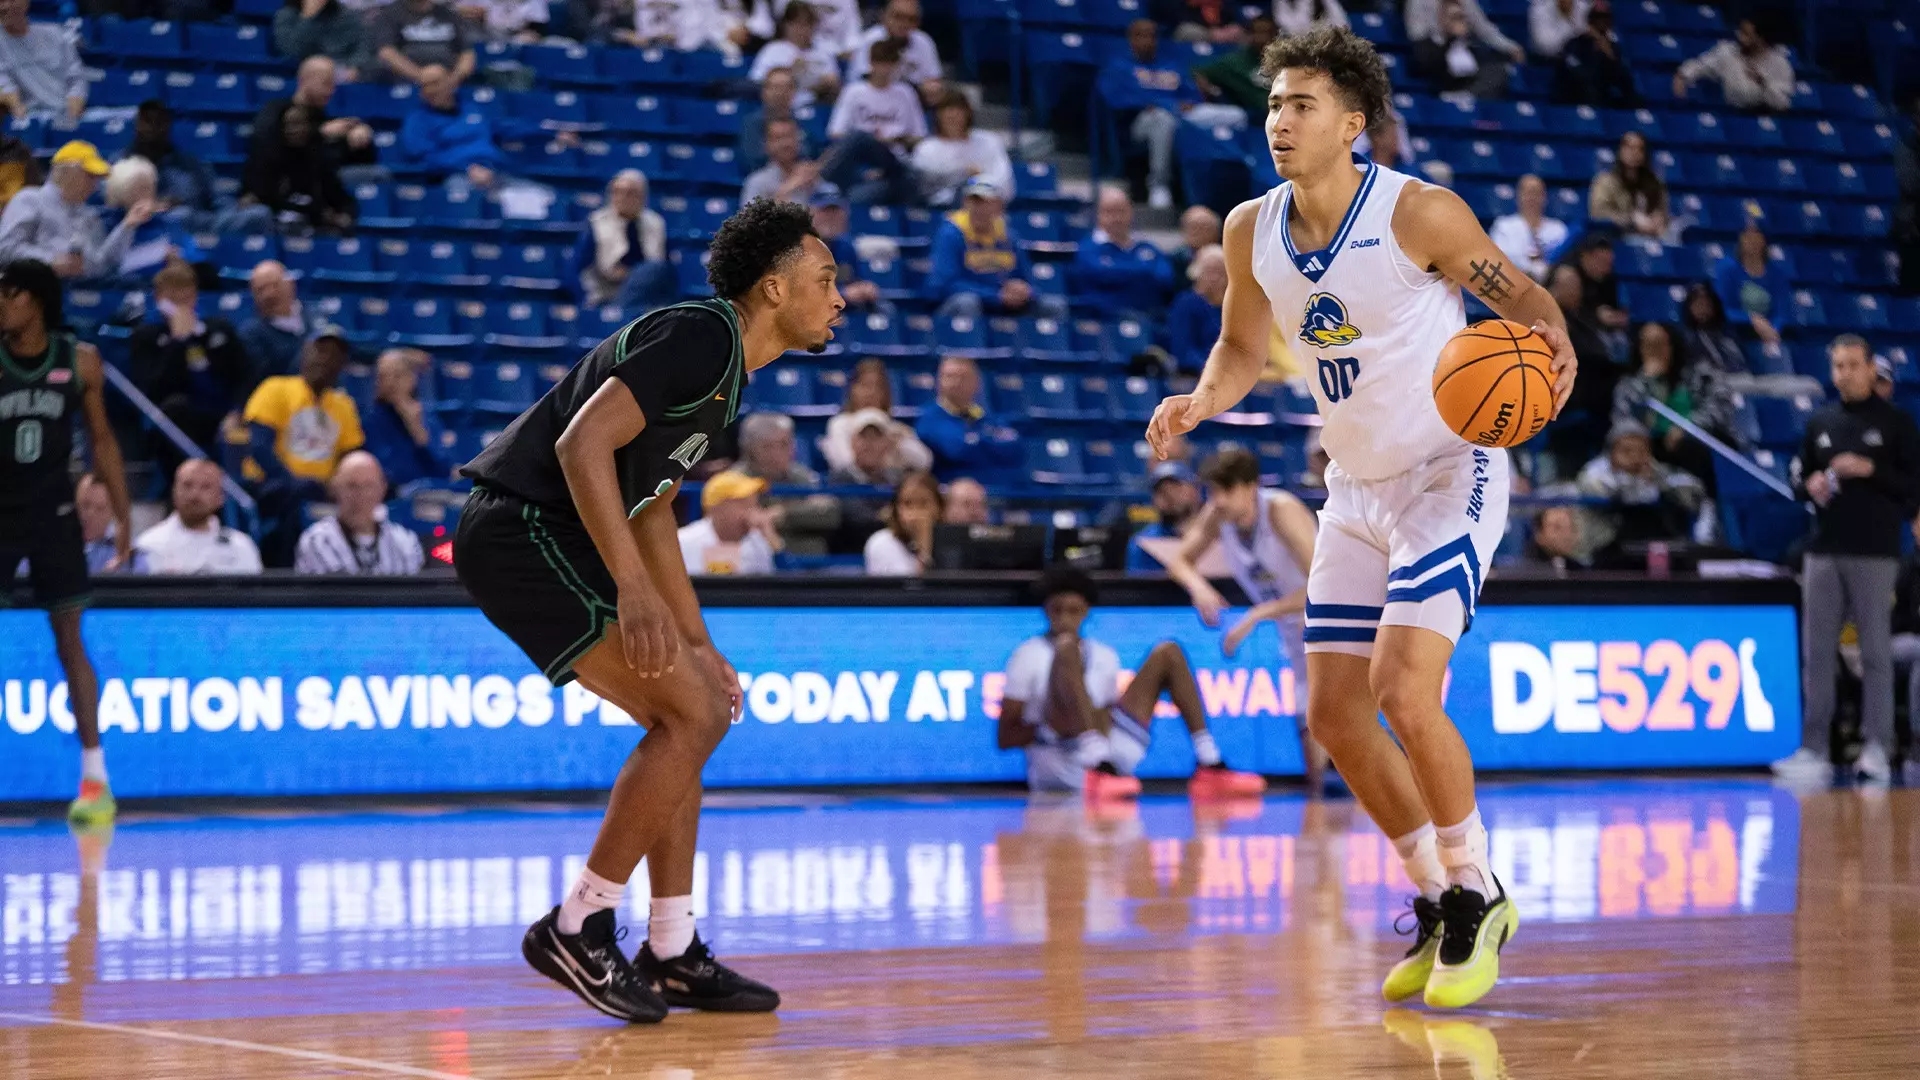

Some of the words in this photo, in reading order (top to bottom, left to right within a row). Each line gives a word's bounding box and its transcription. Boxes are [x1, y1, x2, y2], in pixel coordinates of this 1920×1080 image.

[1316, 356, 1361, 403] 00
[14, 419, 43, 463] 0
[1473, 401, 1517, 447] ilson
[0, 676, 283, 735] UCATION
[296, 674, 554, 731] SAVINGS
[905, 670, 974, 722] AT
[1488, 638, 1741, 734] DE529
